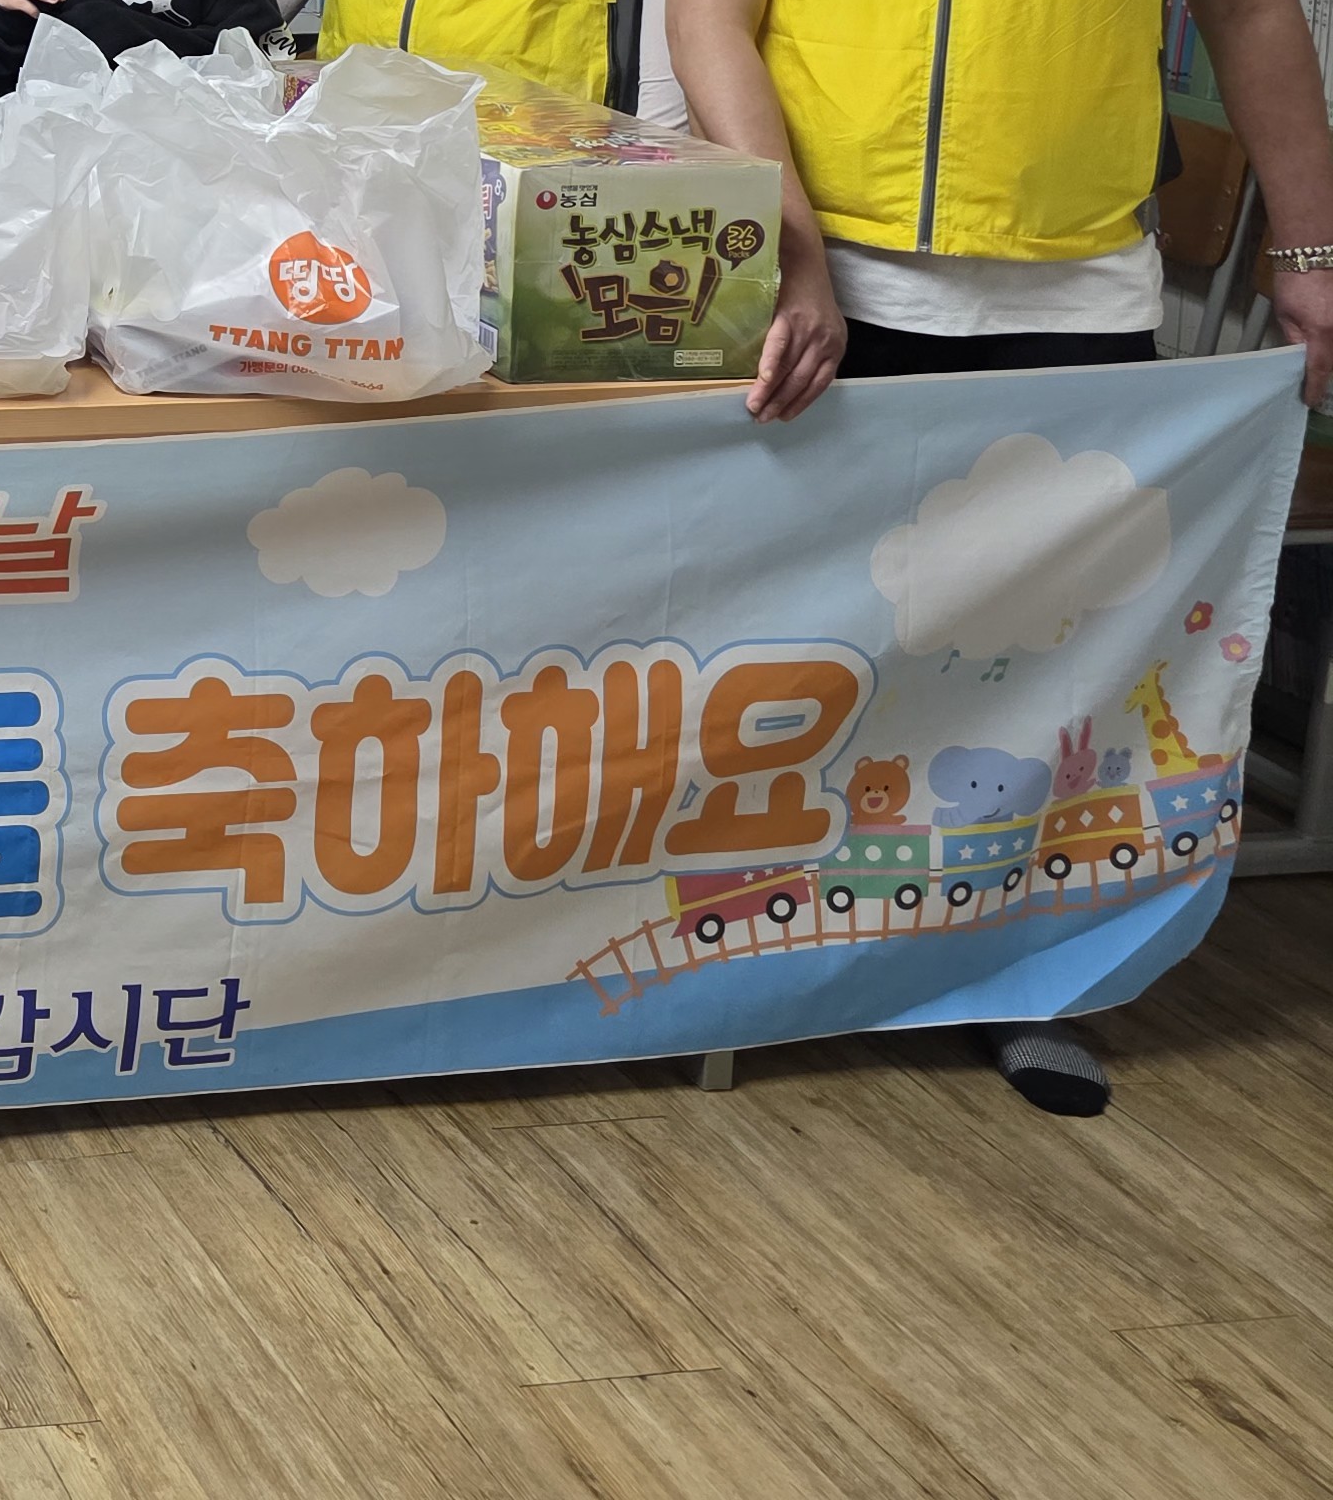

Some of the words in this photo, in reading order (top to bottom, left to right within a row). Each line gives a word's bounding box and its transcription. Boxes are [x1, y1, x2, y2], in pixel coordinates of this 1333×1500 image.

[559, 192, 598, 208] 농심
[561, 208, 717, 268] 농심스낵
[726, 225, 757, 250] 36
[728, 250, 750, 258] Packs
[209, 324, 313, 357] TTANG
[324, 337, 405, 361] TTAN
[240, 361, 287, 374] 가맹문의
[117, 654, 859, 904] 축하해요
